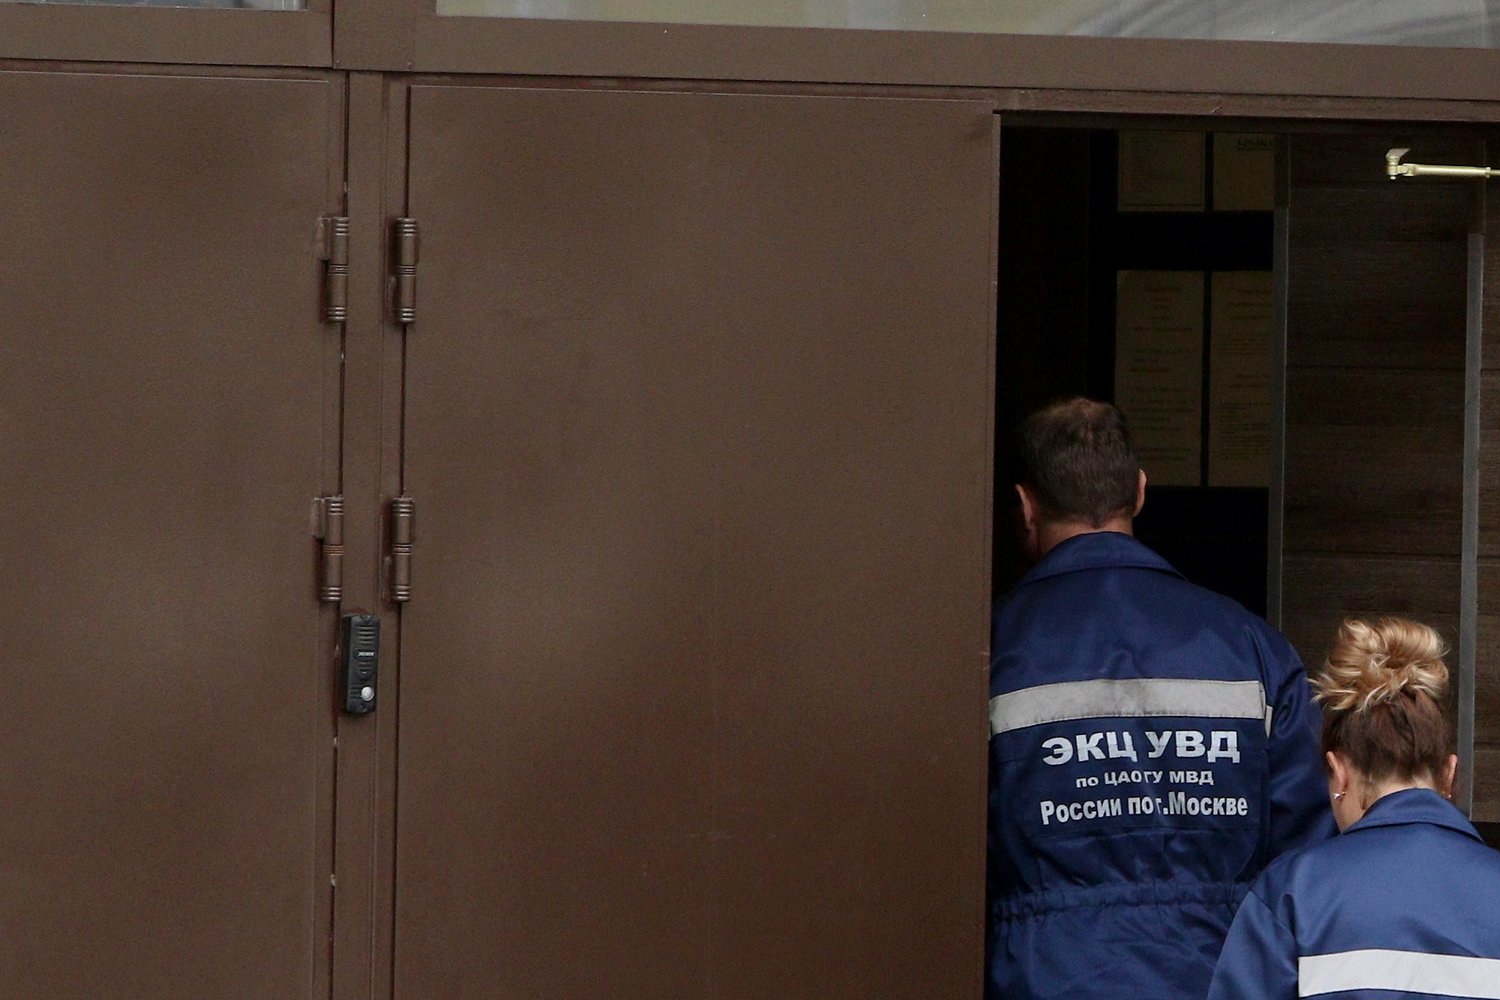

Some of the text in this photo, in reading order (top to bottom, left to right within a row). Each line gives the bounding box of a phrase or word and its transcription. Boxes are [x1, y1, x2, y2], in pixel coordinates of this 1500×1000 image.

[1041, 730, 1241, 766] ЭКЦ УВД
[1076, 776, 1099, 788] по
[1169, 770, 1215, 786] МВД
[1040, 800, 1122, 825] России
